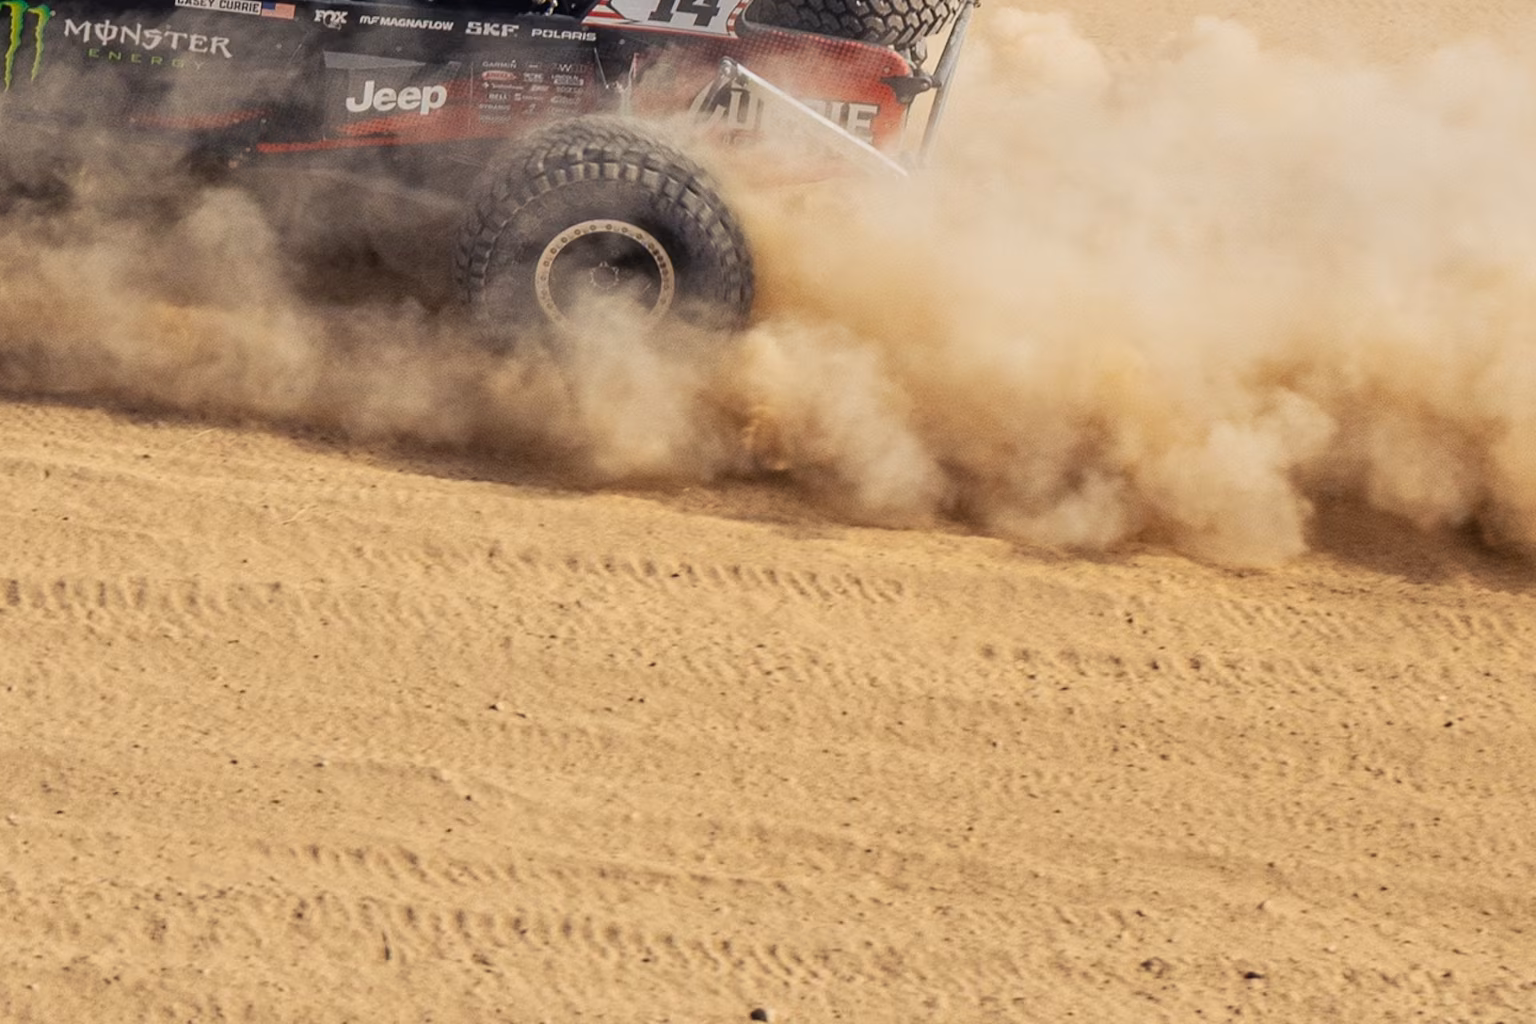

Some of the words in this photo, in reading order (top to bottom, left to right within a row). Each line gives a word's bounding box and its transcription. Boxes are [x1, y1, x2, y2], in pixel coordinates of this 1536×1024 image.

[219, 0, 260, 13] CURRIE
[314, 9, 348, 26] FOX
[380, 17, 454, 31] MAGNAFLOW
[465, 21, 519, 37] SKF
[531, 28, 597, 42] POLARIS
[88, 48, 206, 71] ENERGY
[346, 80, 448, 116] Jeep
